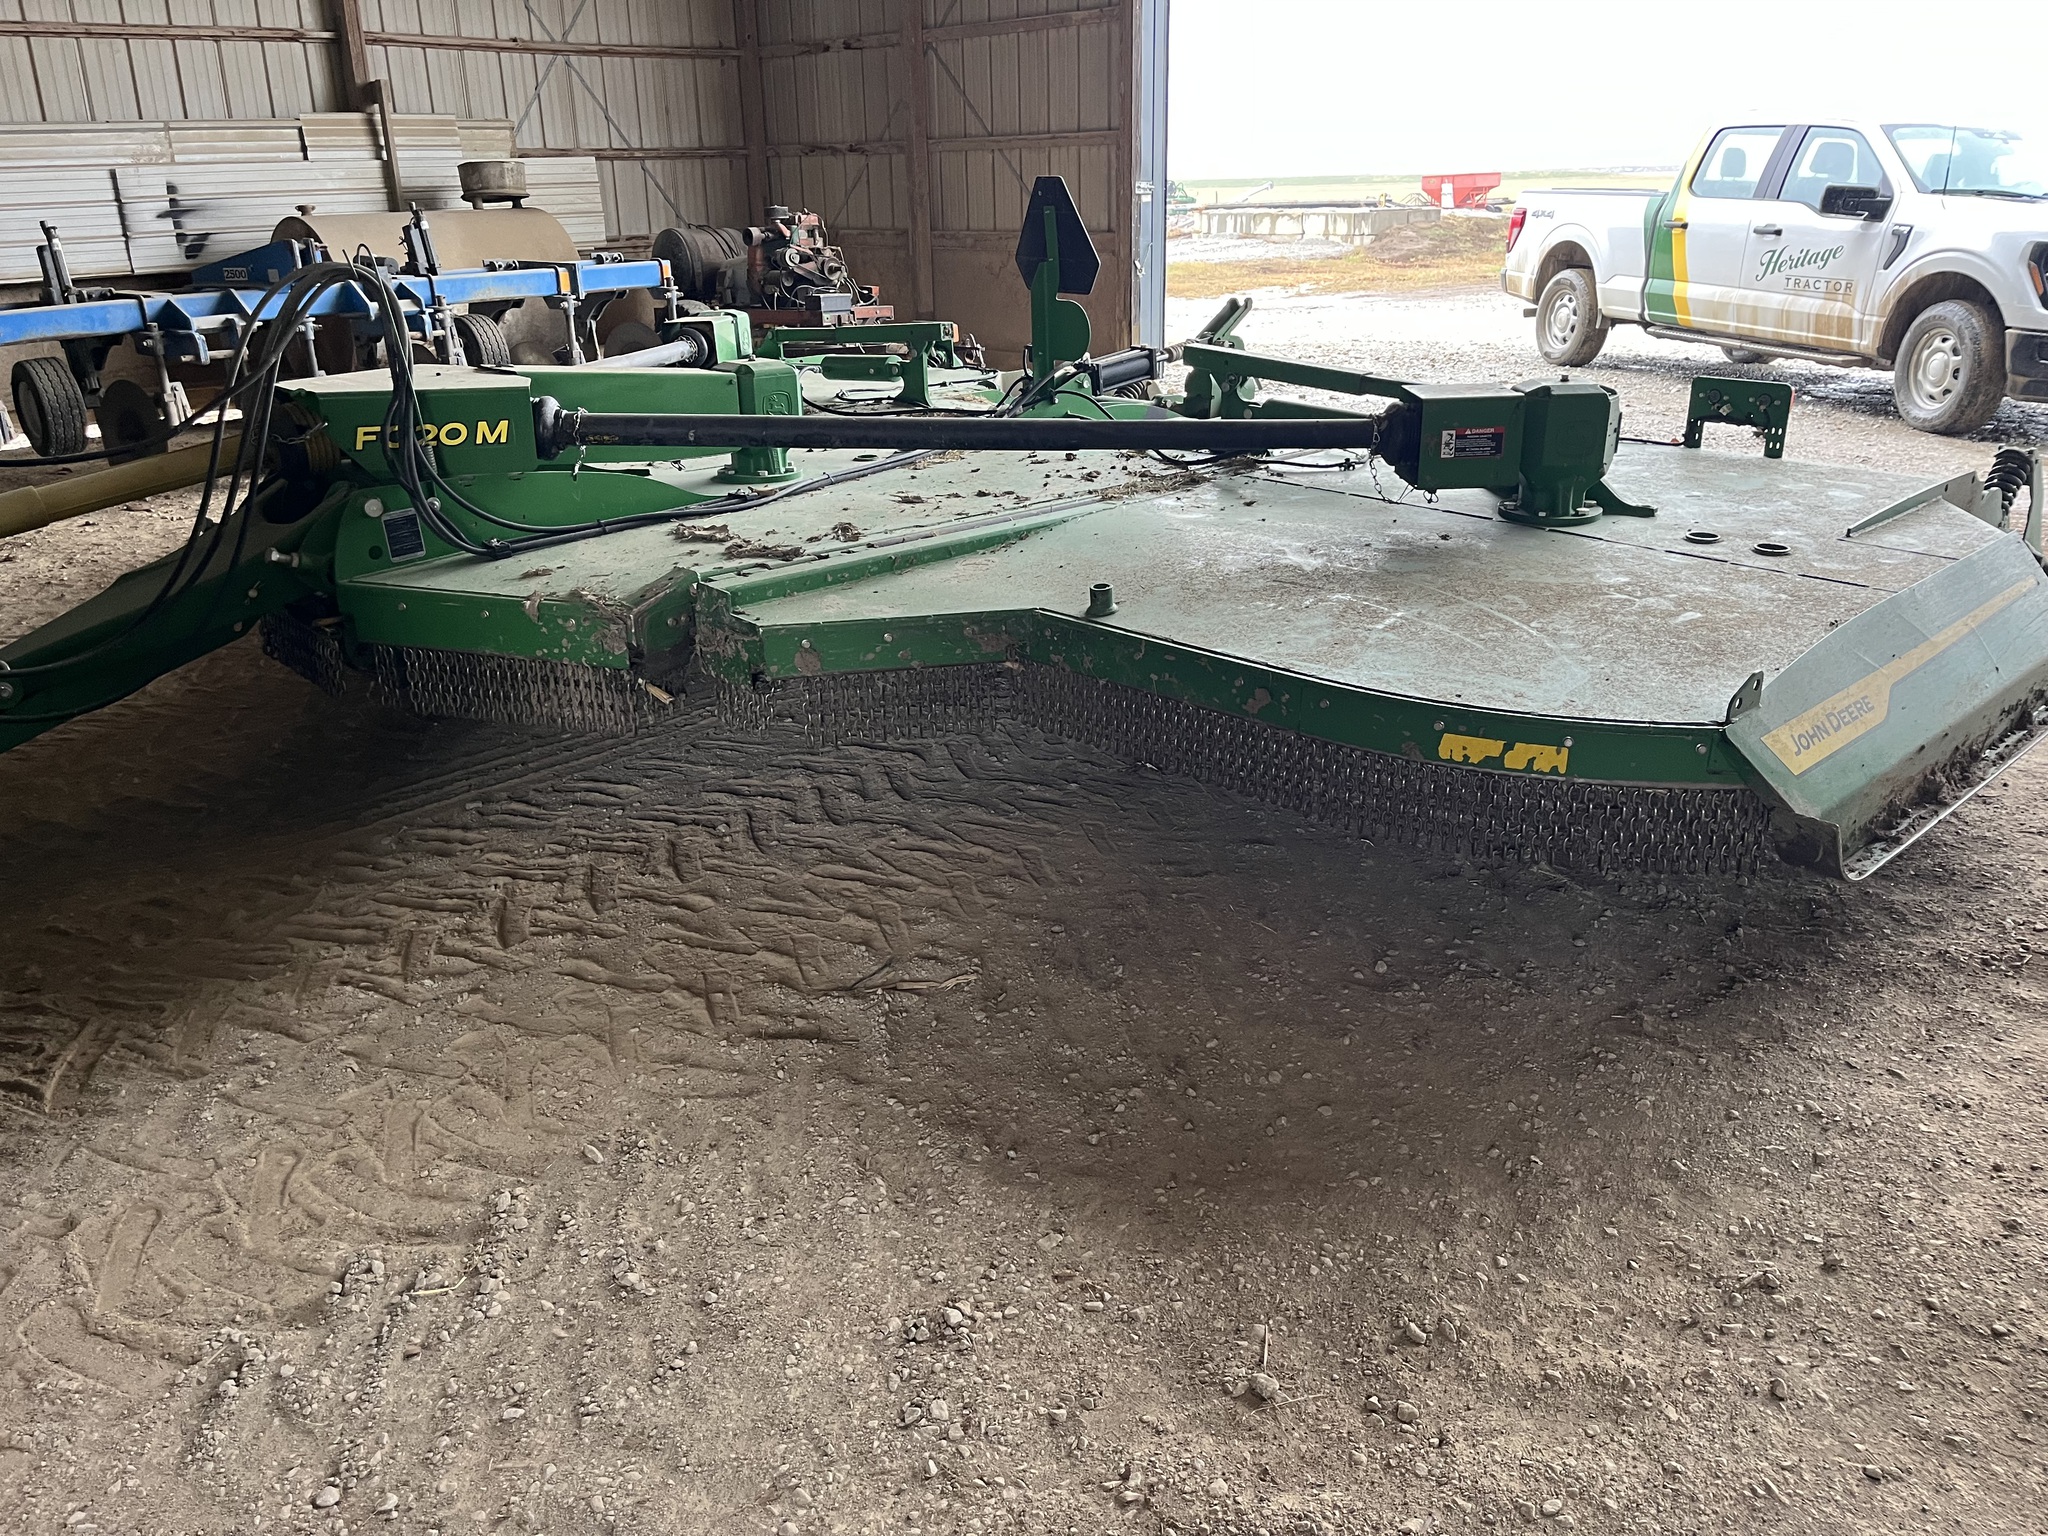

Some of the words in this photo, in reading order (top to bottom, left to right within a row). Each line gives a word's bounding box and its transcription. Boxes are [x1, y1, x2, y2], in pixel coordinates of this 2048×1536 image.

[224, 269, 247, 279] 2500
[1755, 244, 1845, 282] Heritage
[1785, 277, 1853, 293] TRACTOR
[475, 419, 509, 444] M
[1790, 720, 1832, 757] JOHN
[1825, 695, 1875, 733] DEERE
